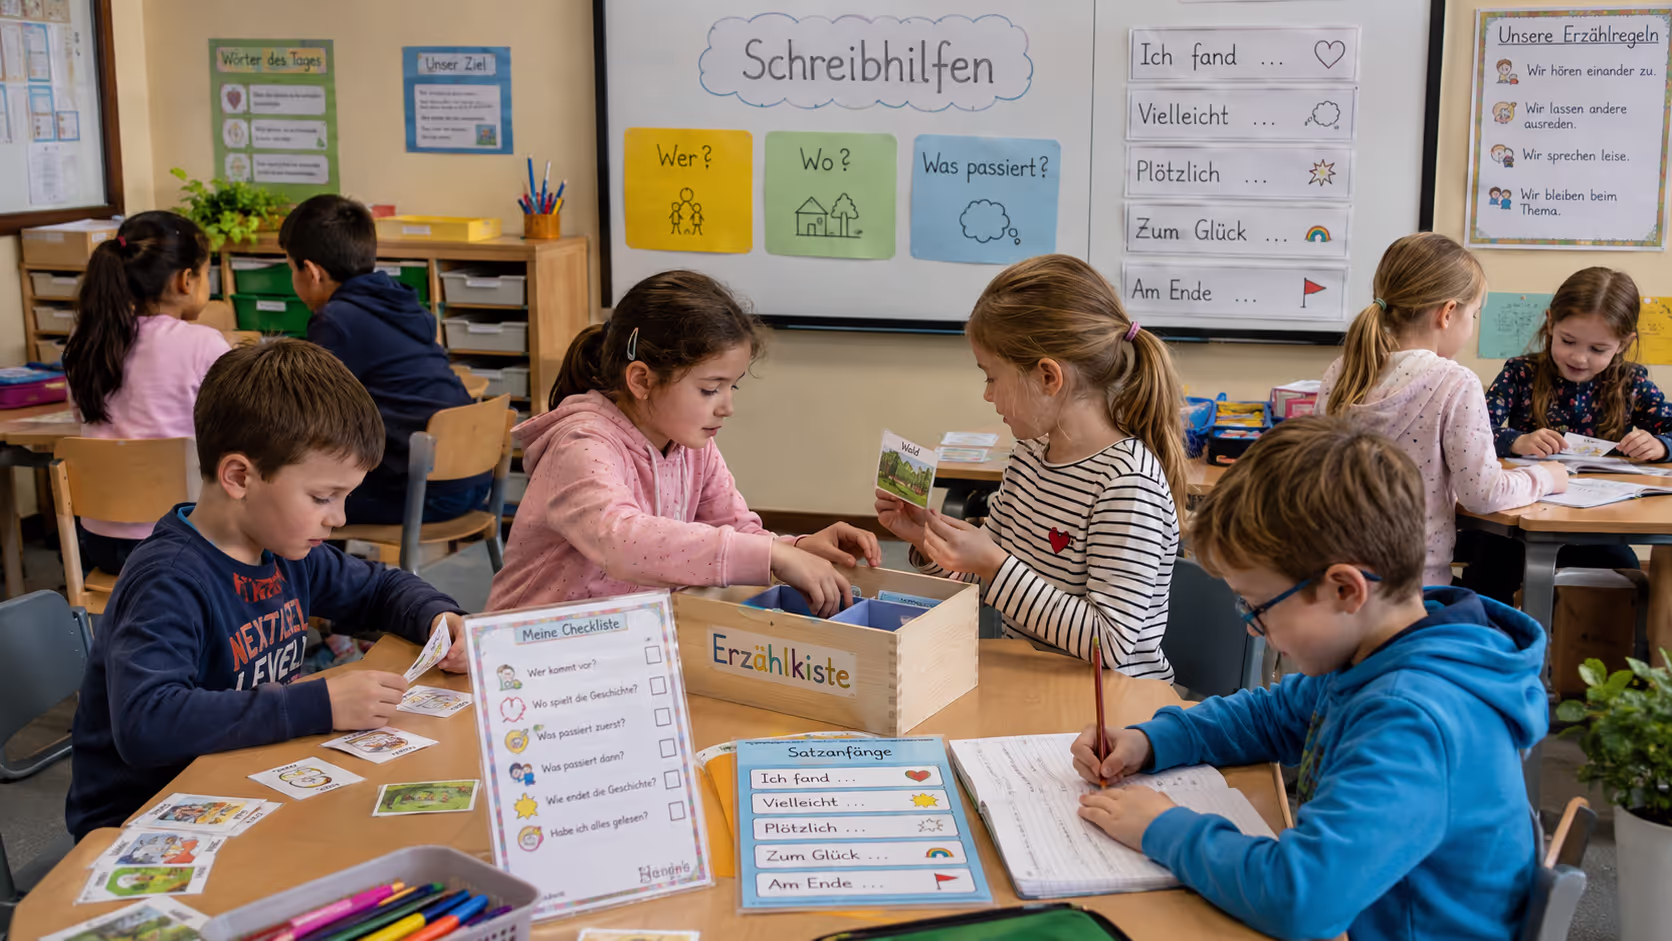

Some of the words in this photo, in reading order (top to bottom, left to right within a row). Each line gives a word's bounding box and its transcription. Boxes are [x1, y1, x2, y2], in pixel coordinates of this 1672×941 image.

[1497, 25, 1554, 45] Unsere
[1562, 24, 1660, 49] Erzählregeln
[221, 49, 261, 66] Wörter
[268, 51, 286, 66] des
[290, 51, 321, 71] Tages
[426, 57, 458, 70] Unser
[465, 57, 486, 71] Ziel
[742, 38, 994, 94] Schreibhilfen
[1140, 42, 1173, 66] Ich
[1191, 42, 1237, 72] fand
[1526, 63, 1547, 77] Wir
[1550, 63, 1582, 77] hören
[1586, 63, 1635, 77] einander
[1639, 68, 1657, 78] zu.
[1138, 102, 1229, 126] Vielleicht
[1524, 101, 1545, 114] Wir
[1549, 101, 1585, 115] lassen
[1589, 101, 1628, 115] andere
[1523, 116, 1577, 131] ausreden.
[656, 143, 712, 169] Wer?
[799, 147, 851, 172] Wo?
[922, 151, 959, 175] Was
[966, 155, 1049, 184] passiert?
[1522, 147, 1543, 161] Wir
[1546, 148, 1596, 165] sprechen
[1600, 148, 1631, 163] leise.
[1137, 159, 1220, 183] Plötzlich
[1520, 187, 1541, 201] Wir
[1545, 187, 1585, 201] bleiben
[1590, 188, 1618, 202] beim
[1519, 202, 1562, 217] Thema.
[1135, 217, 1180, 241] Zum
[1194, 218, 1248, 242] Glück
[1131, 277, 1161, 300] Am
[1169, 278, 1212, 302] Ende
[901, 441, 921, 457] Wald
[522, 628, 558, 642] Meine
[561, 618, 620, 636] Checkliste
[526, 667, 547, 678] Wer
[547, 663, 577, 675] kommt
[577, 658, 597, 670] vor?
[713, 633, 851, 689] Erzählkiste
[531, 699, 548, 710] Wo
[549, 695, 573, 709] spielt
[574, 693, 588, 703] die
[589, 683, 638, 701] Geschichte?
[537, 730, 558, 742] Was
[558, 724, 593, 741] passiert
[595, 717, 626, 732] zuerst?
[540, 762, 562, 774] Was
[563, 756, 598, 773] passiert
[599, 750, 625, 764] dann?
[788, 745, 893, 761] Satzanfänge
[545, 794, 564, 806] Wie
[565, 790, 591, 803] endet
[592, 787, 607, 798] die
[607, 776, 657, 795] Geschichte?
[760, 773, 787, 784] Ich
[793, 772, 830, 786] fand
[762, 797, 839, 808] Vielleicht
[549, 826, 574, 838] Habe
[575, 822, 590, 834] ich
[590, 820, 611, 831] alles
[612, 810, 649, 830] gelesen?
[764, 822, 838, 834] Plötzlich
[766, 850, 806, 862] Zum
[811, 848, 861, 861] Glück
[768, 878, 800, 890] Am
[807, 876, 853, 889] Ende
